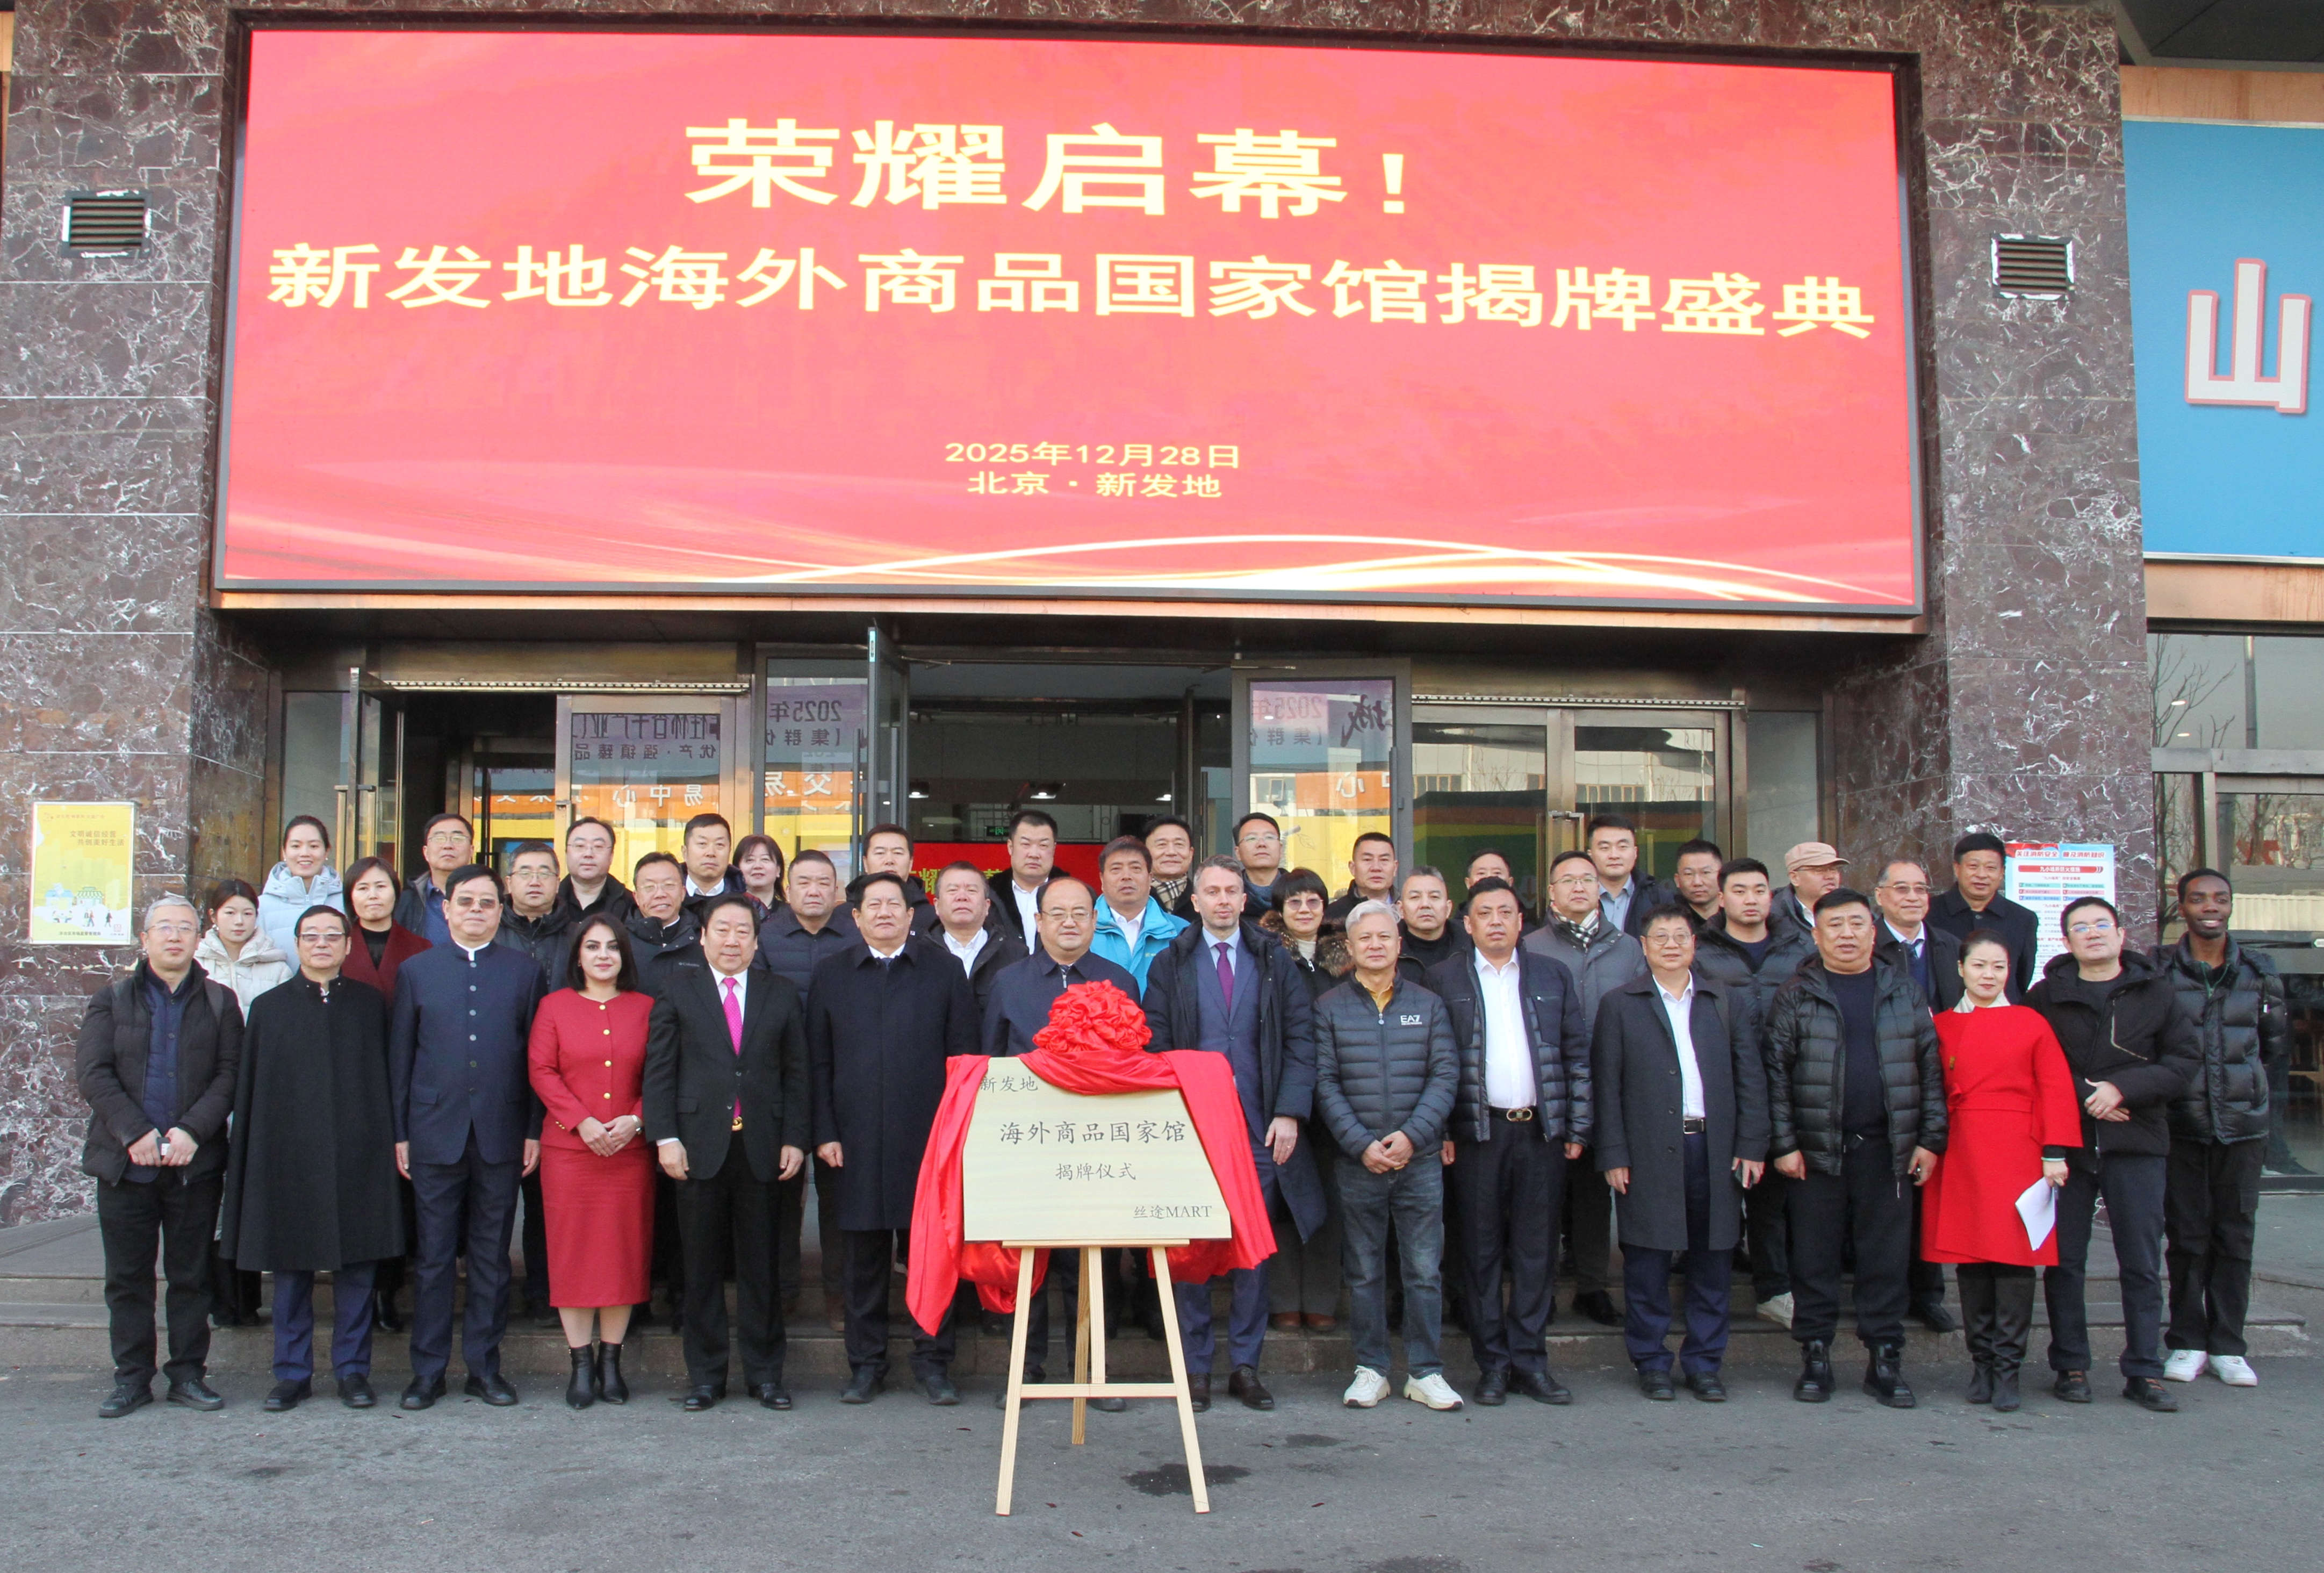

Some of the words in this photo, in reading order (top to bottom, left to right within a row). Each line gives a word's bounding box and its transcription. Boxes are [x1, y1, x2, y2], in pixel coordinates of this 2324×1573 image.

[684, 118, 1405, 219] 荣耀启幕！
[267, 242, 1875, 339] 新发地海外商品国家馆揭牌盛典
[2185, 258, 2311, 413] 山
[944, 441, 1239, 469] 2025年12月28日
[1400, 1015, 1420, 1023] EA7
[980, 1075, 1038, 1093] 新发地
[1000, 1121, 1185, 1145] 海外商品国家馆
[1055, 1163, 1136, 1181] 揭牌仪式
[1133, 1205, 1212, 1219] 丝途MART
